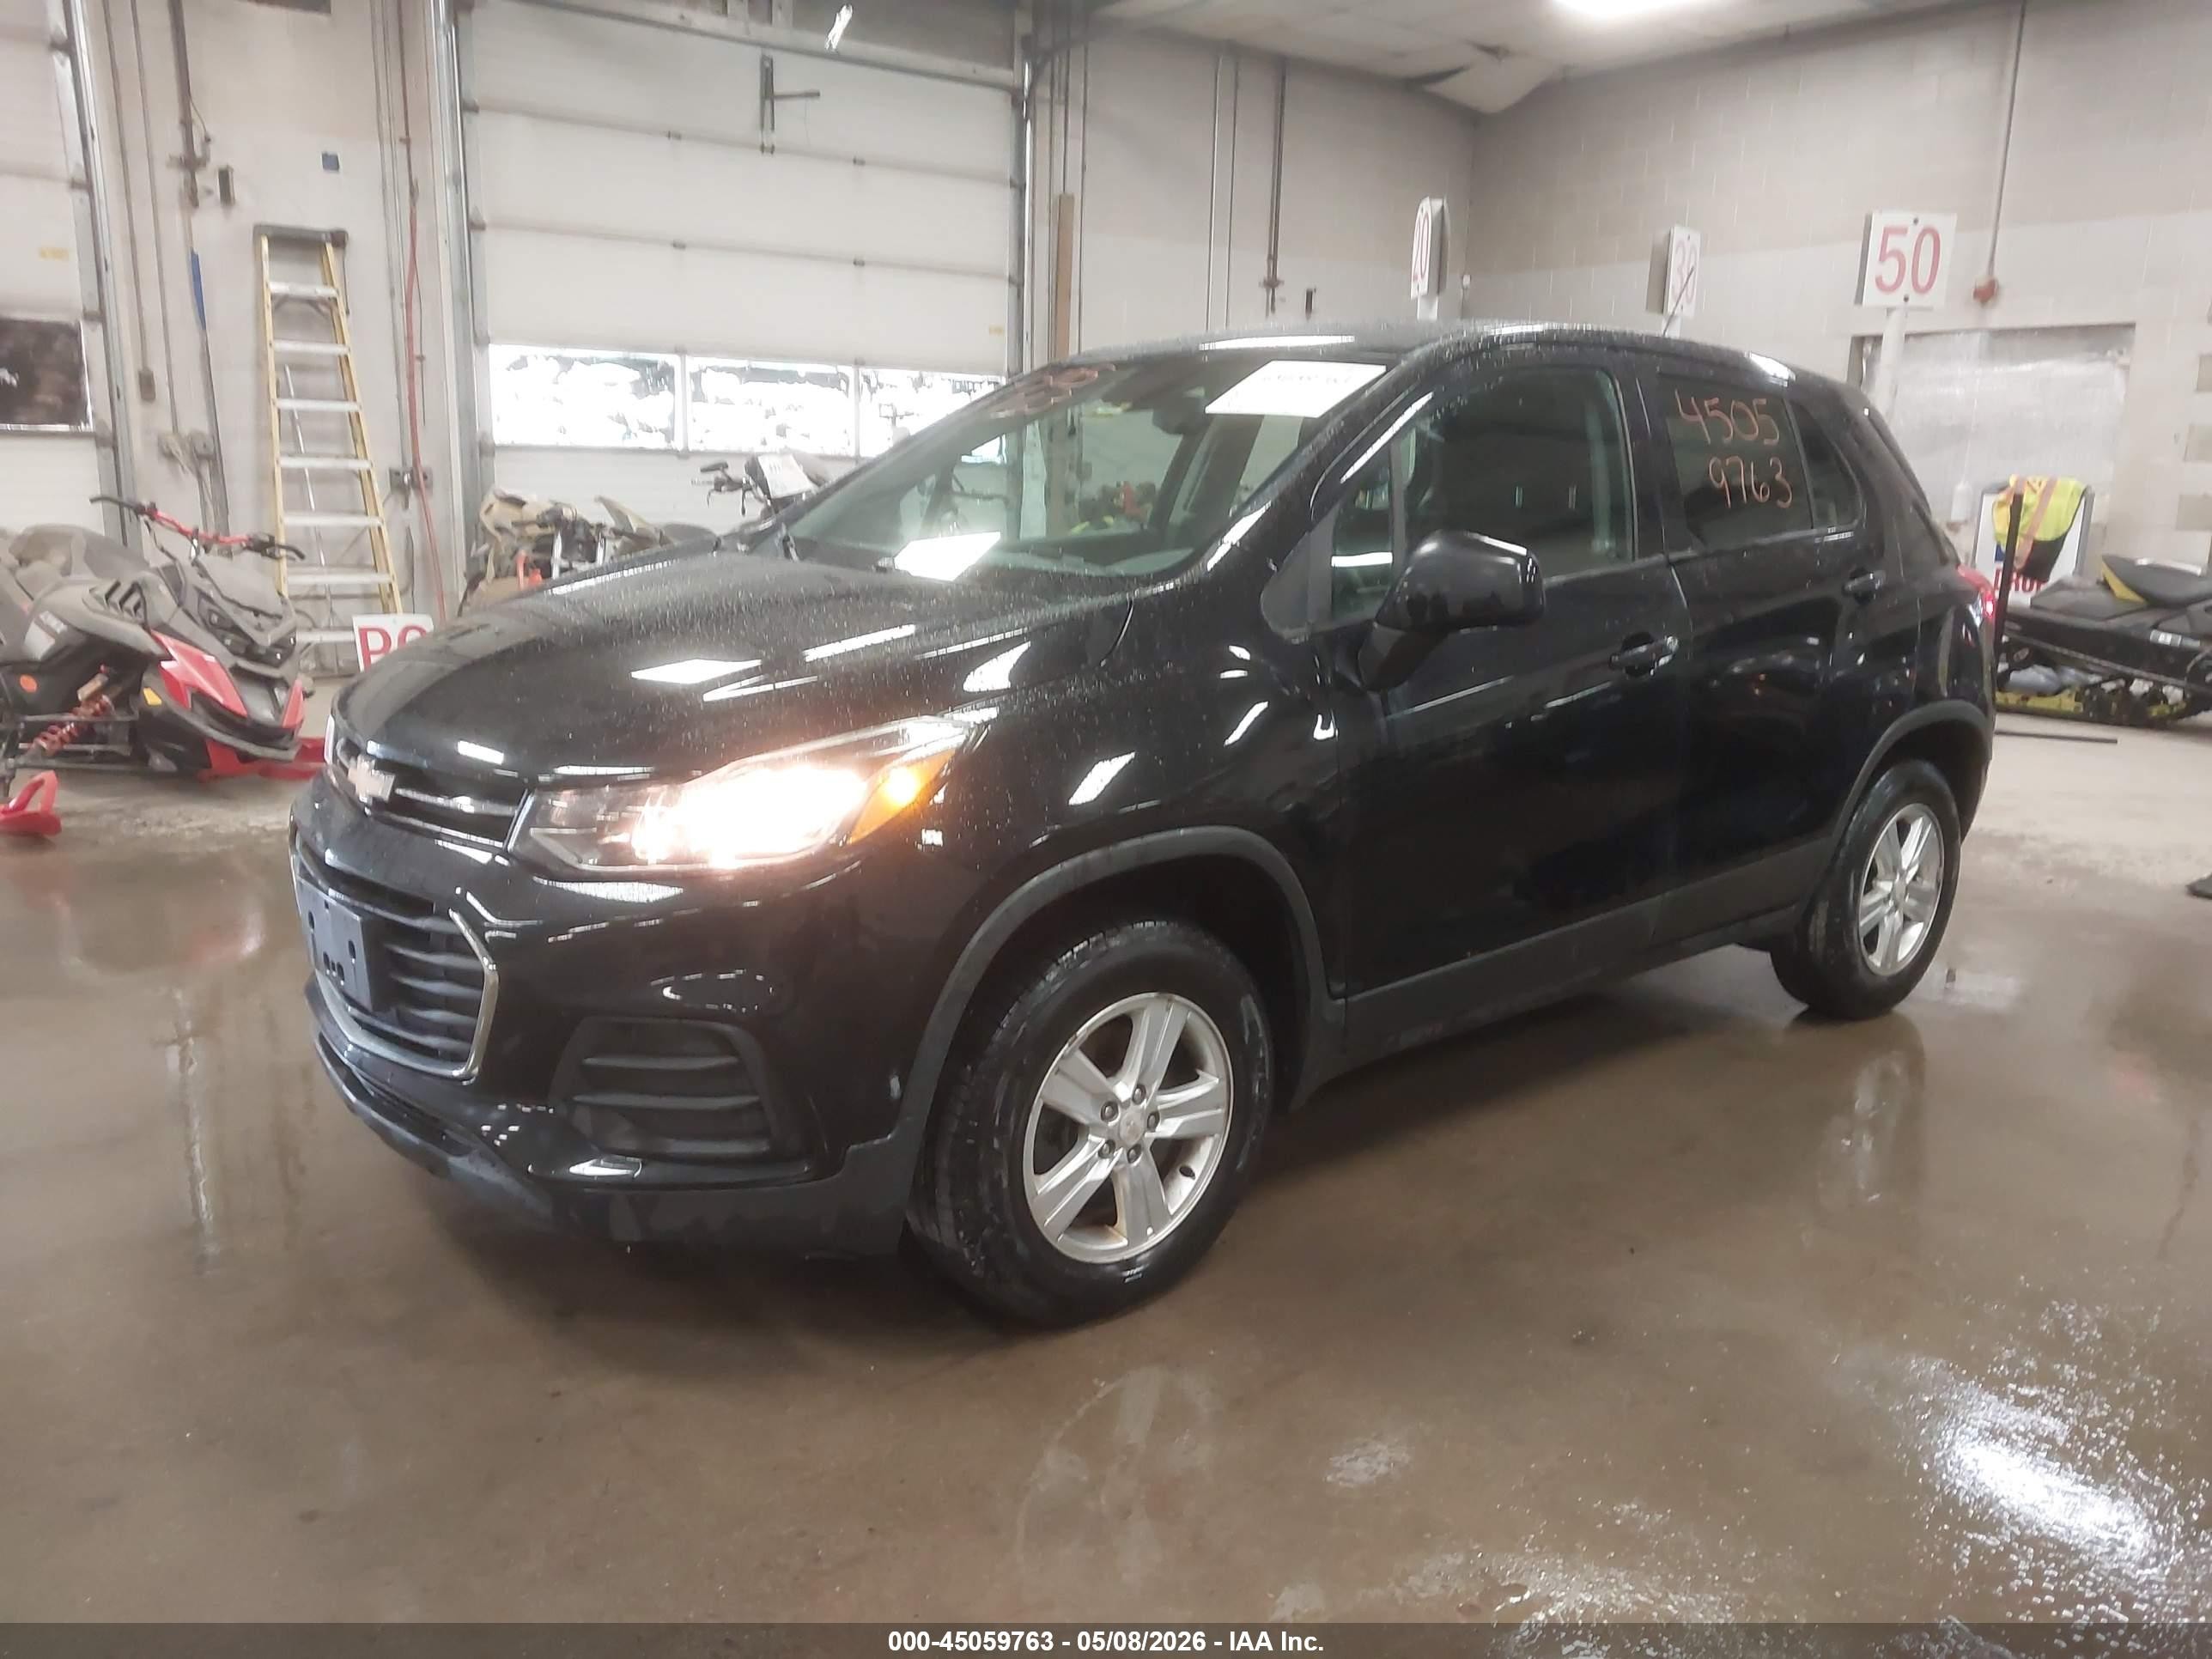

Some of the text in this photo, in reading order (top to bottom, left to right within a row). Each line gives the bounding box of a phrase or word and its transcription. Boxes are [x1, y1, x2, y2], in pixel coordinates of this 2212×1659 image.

[1875, 226, 1941, 295] 50
[1675, 389, 1780, 445] 4505
[1709, 456, 1793, 508] 9763
